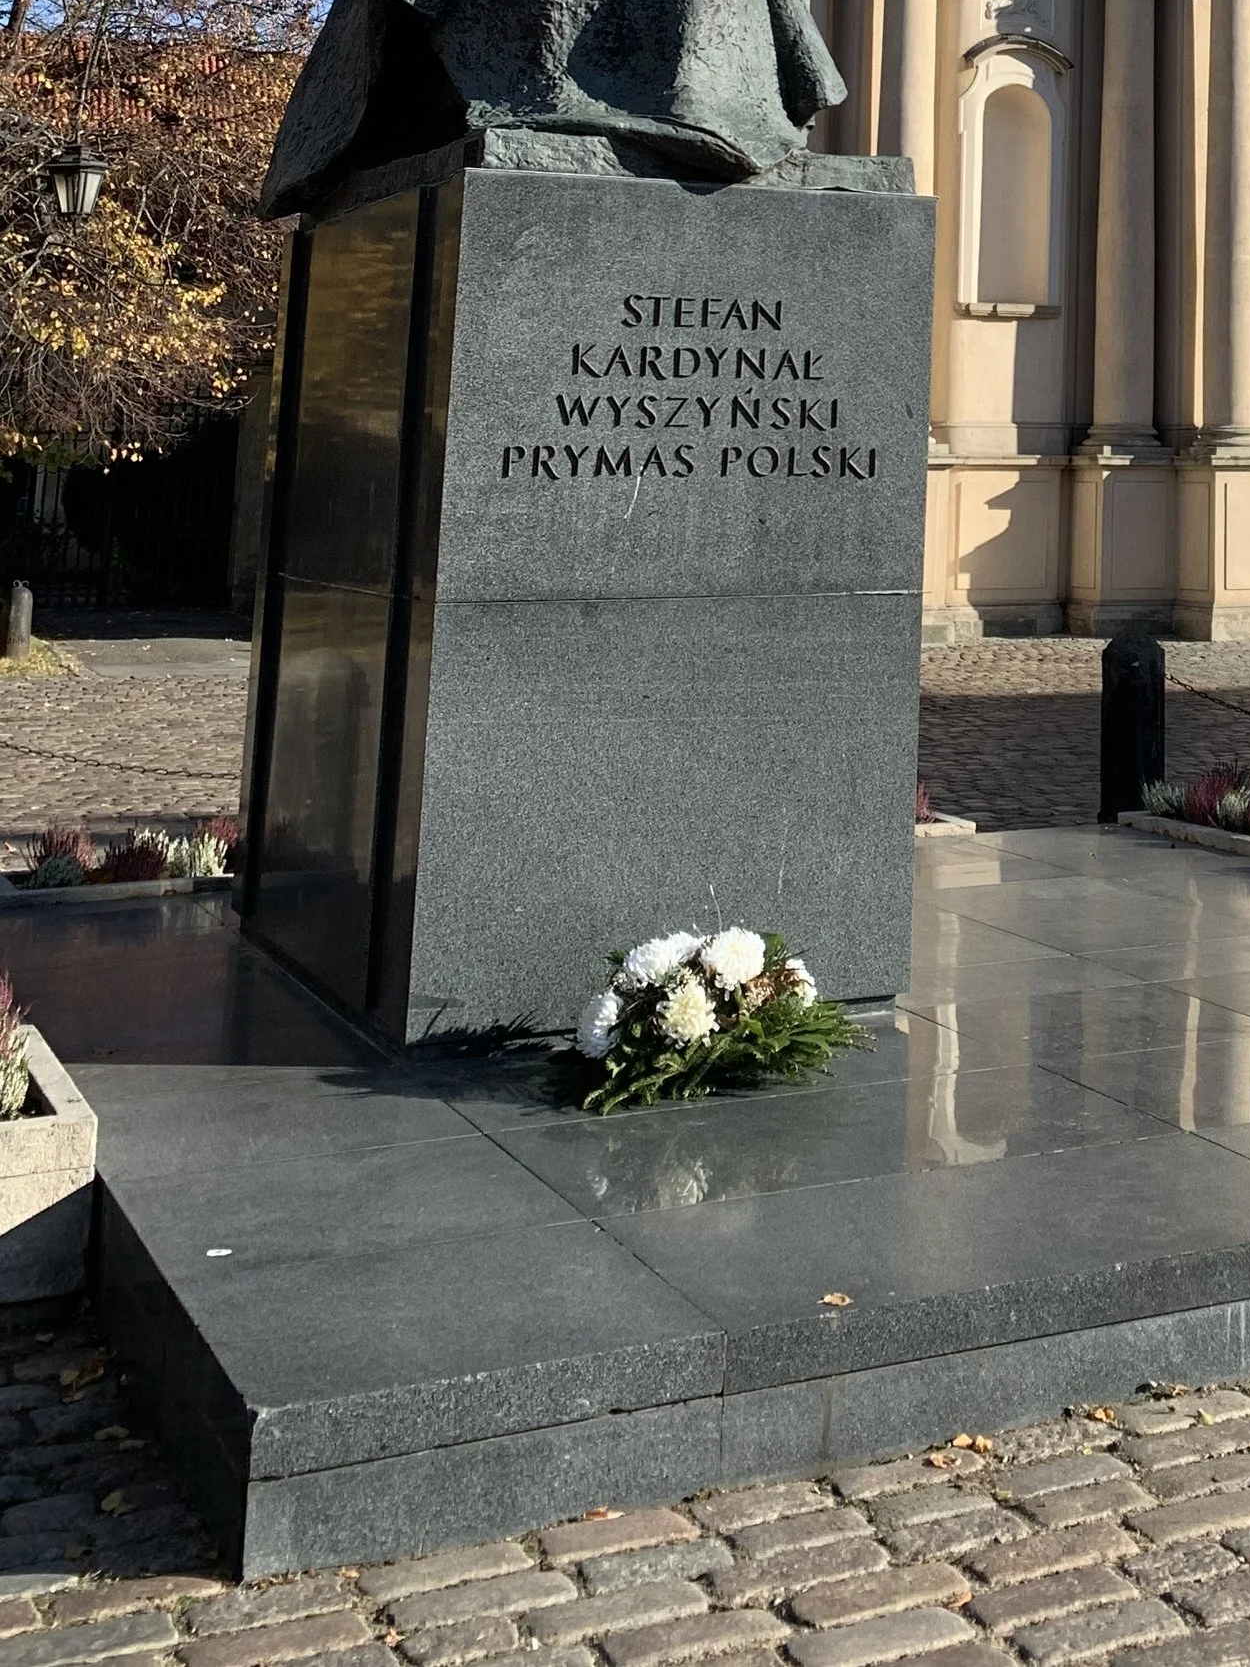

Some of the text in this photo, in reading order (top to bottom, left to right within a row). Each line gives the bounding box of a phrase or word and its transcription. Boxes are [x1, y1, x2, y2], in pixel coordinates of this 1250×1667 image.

[620, 294, 783, 331] STEFAN
[571, 343, 824, 381] KARDYNAŁ
[556, 387, 839, 430] WYSZYŃSKI
[501, 444, 876, 480] PRYMAS POLSKI
